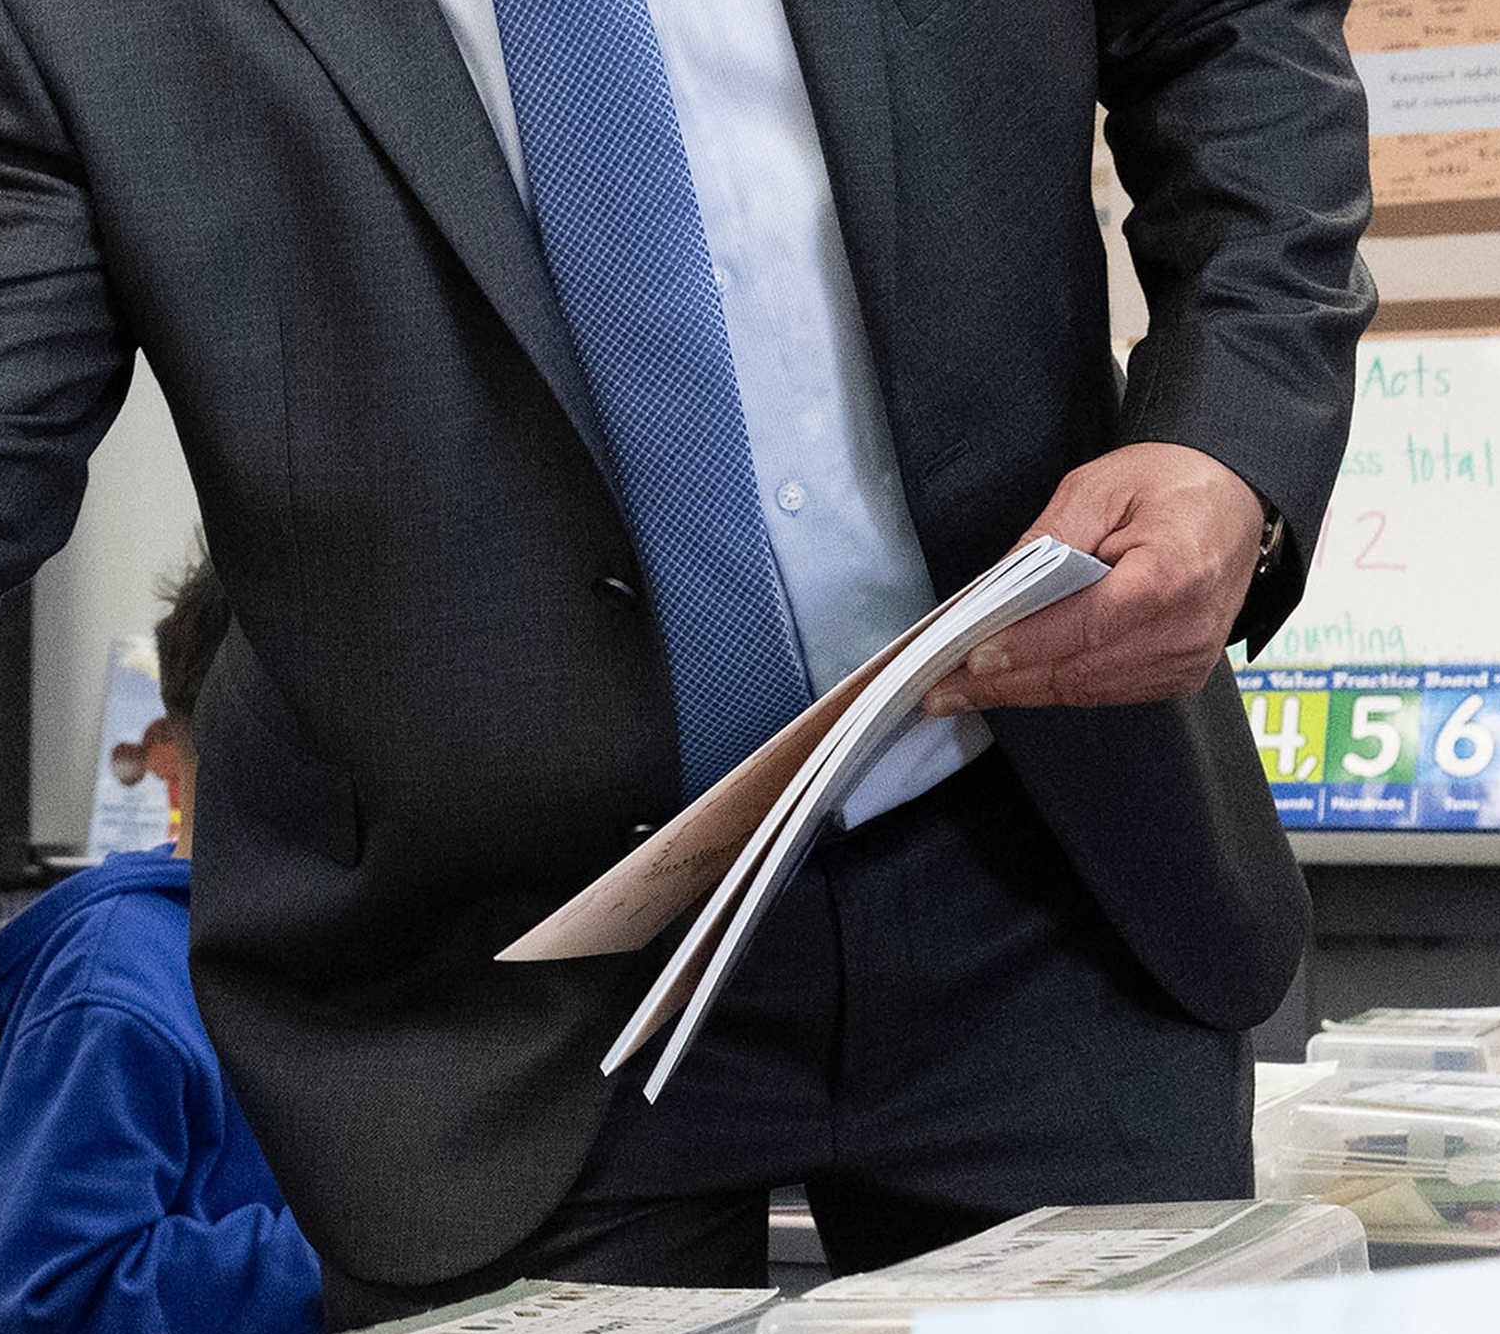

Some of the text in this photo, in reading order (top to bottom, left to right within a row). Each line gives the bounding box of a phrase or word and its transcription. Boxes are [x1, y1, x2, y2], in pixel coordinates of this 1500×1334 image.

[1406, 431, 1495, 487] total
[1270, 671, 1328, 689] Value
[1333, 671, 1419, 689] Practice
[1425, 670, 1489, 688] Board
[1343, 695, 1404, 778] 5
[1434, 693, 1496, 778] 6
